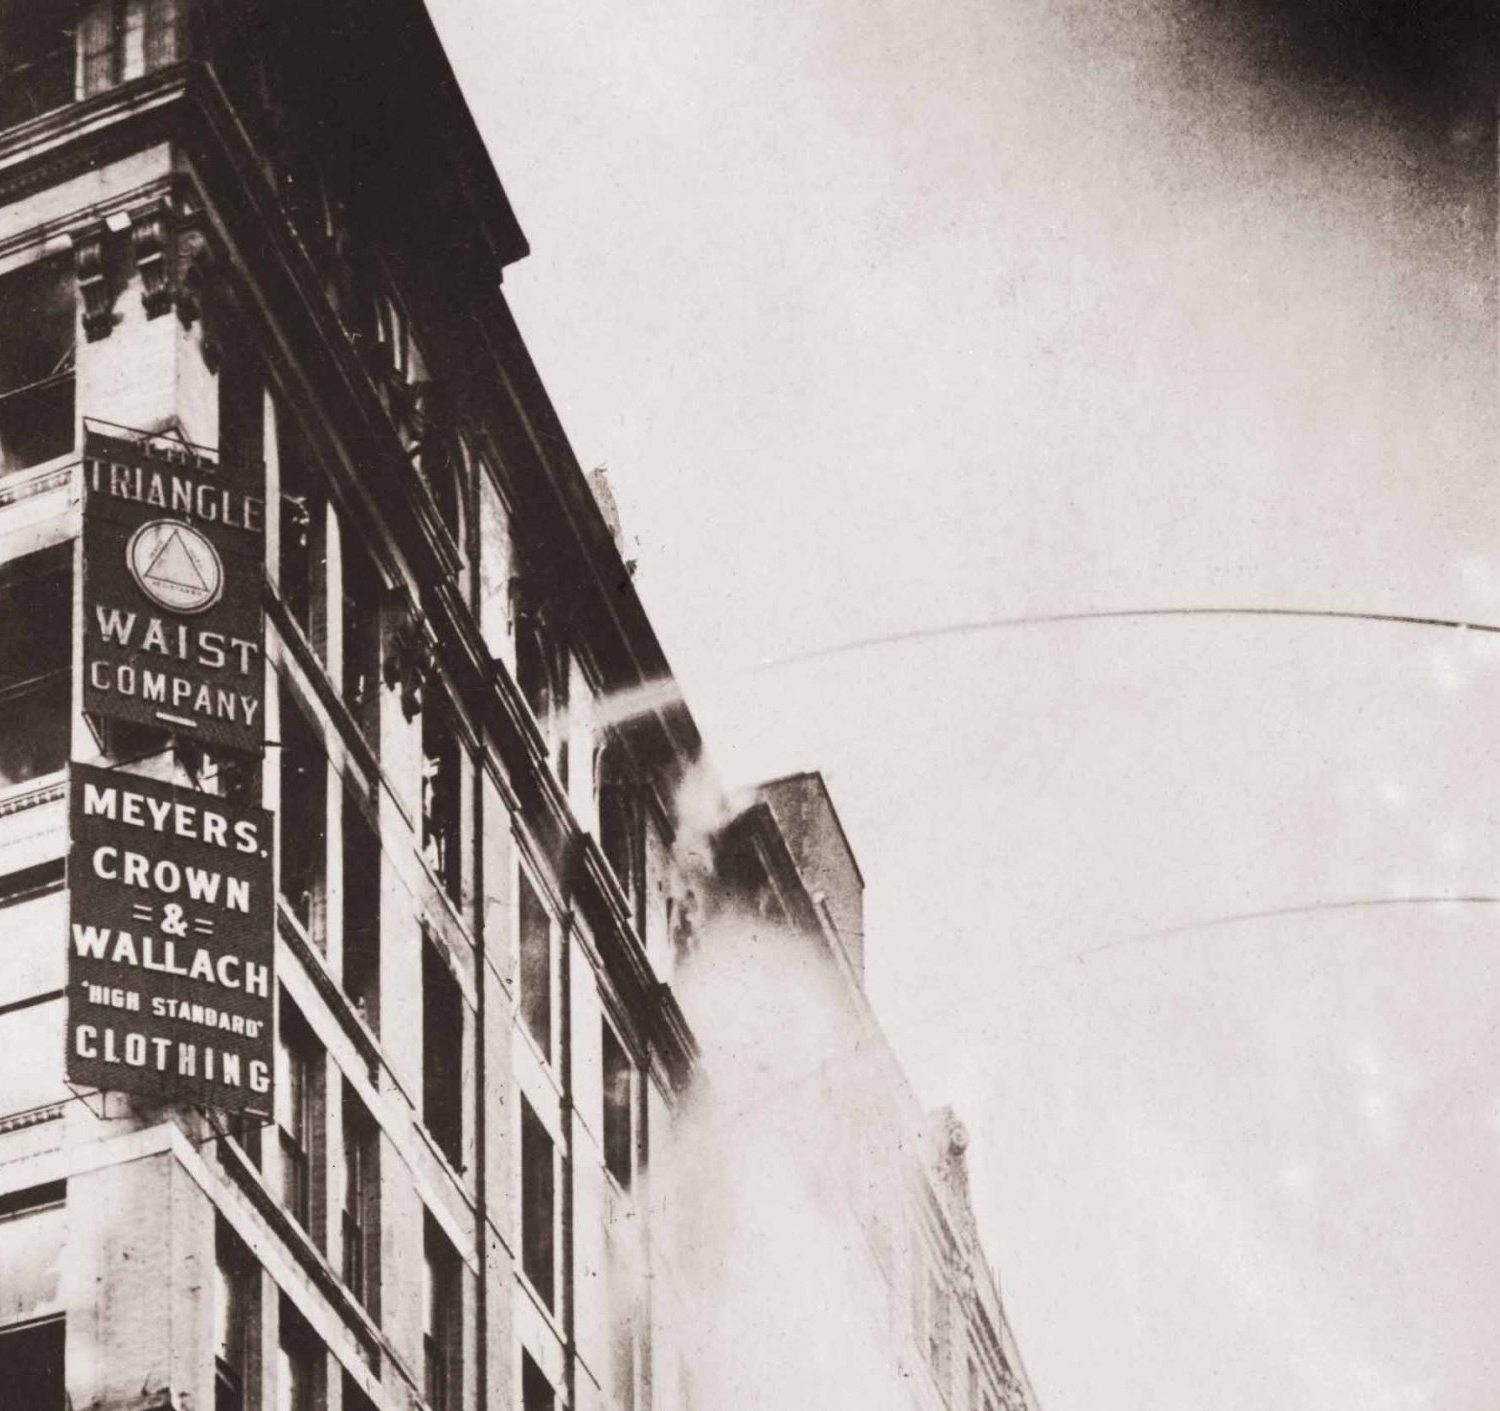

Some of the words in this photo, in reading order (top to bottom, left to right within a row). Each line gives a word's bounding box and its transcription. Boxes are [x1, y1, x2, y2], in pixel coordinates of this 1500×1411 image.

[85, 456, 265, 532] TRIANGLE
[96, 604, 258, 675] WAIST
[91, 660, 259, 726] COMPANY
[84, 783, 269, 858] MEYERS,
[92, 846, 251, 914] CROWN
[160, 903, 188, 938] &
[71, 922, 269, 998] WALLACH
[75, 1024, 271, 1094] CLOTHING
